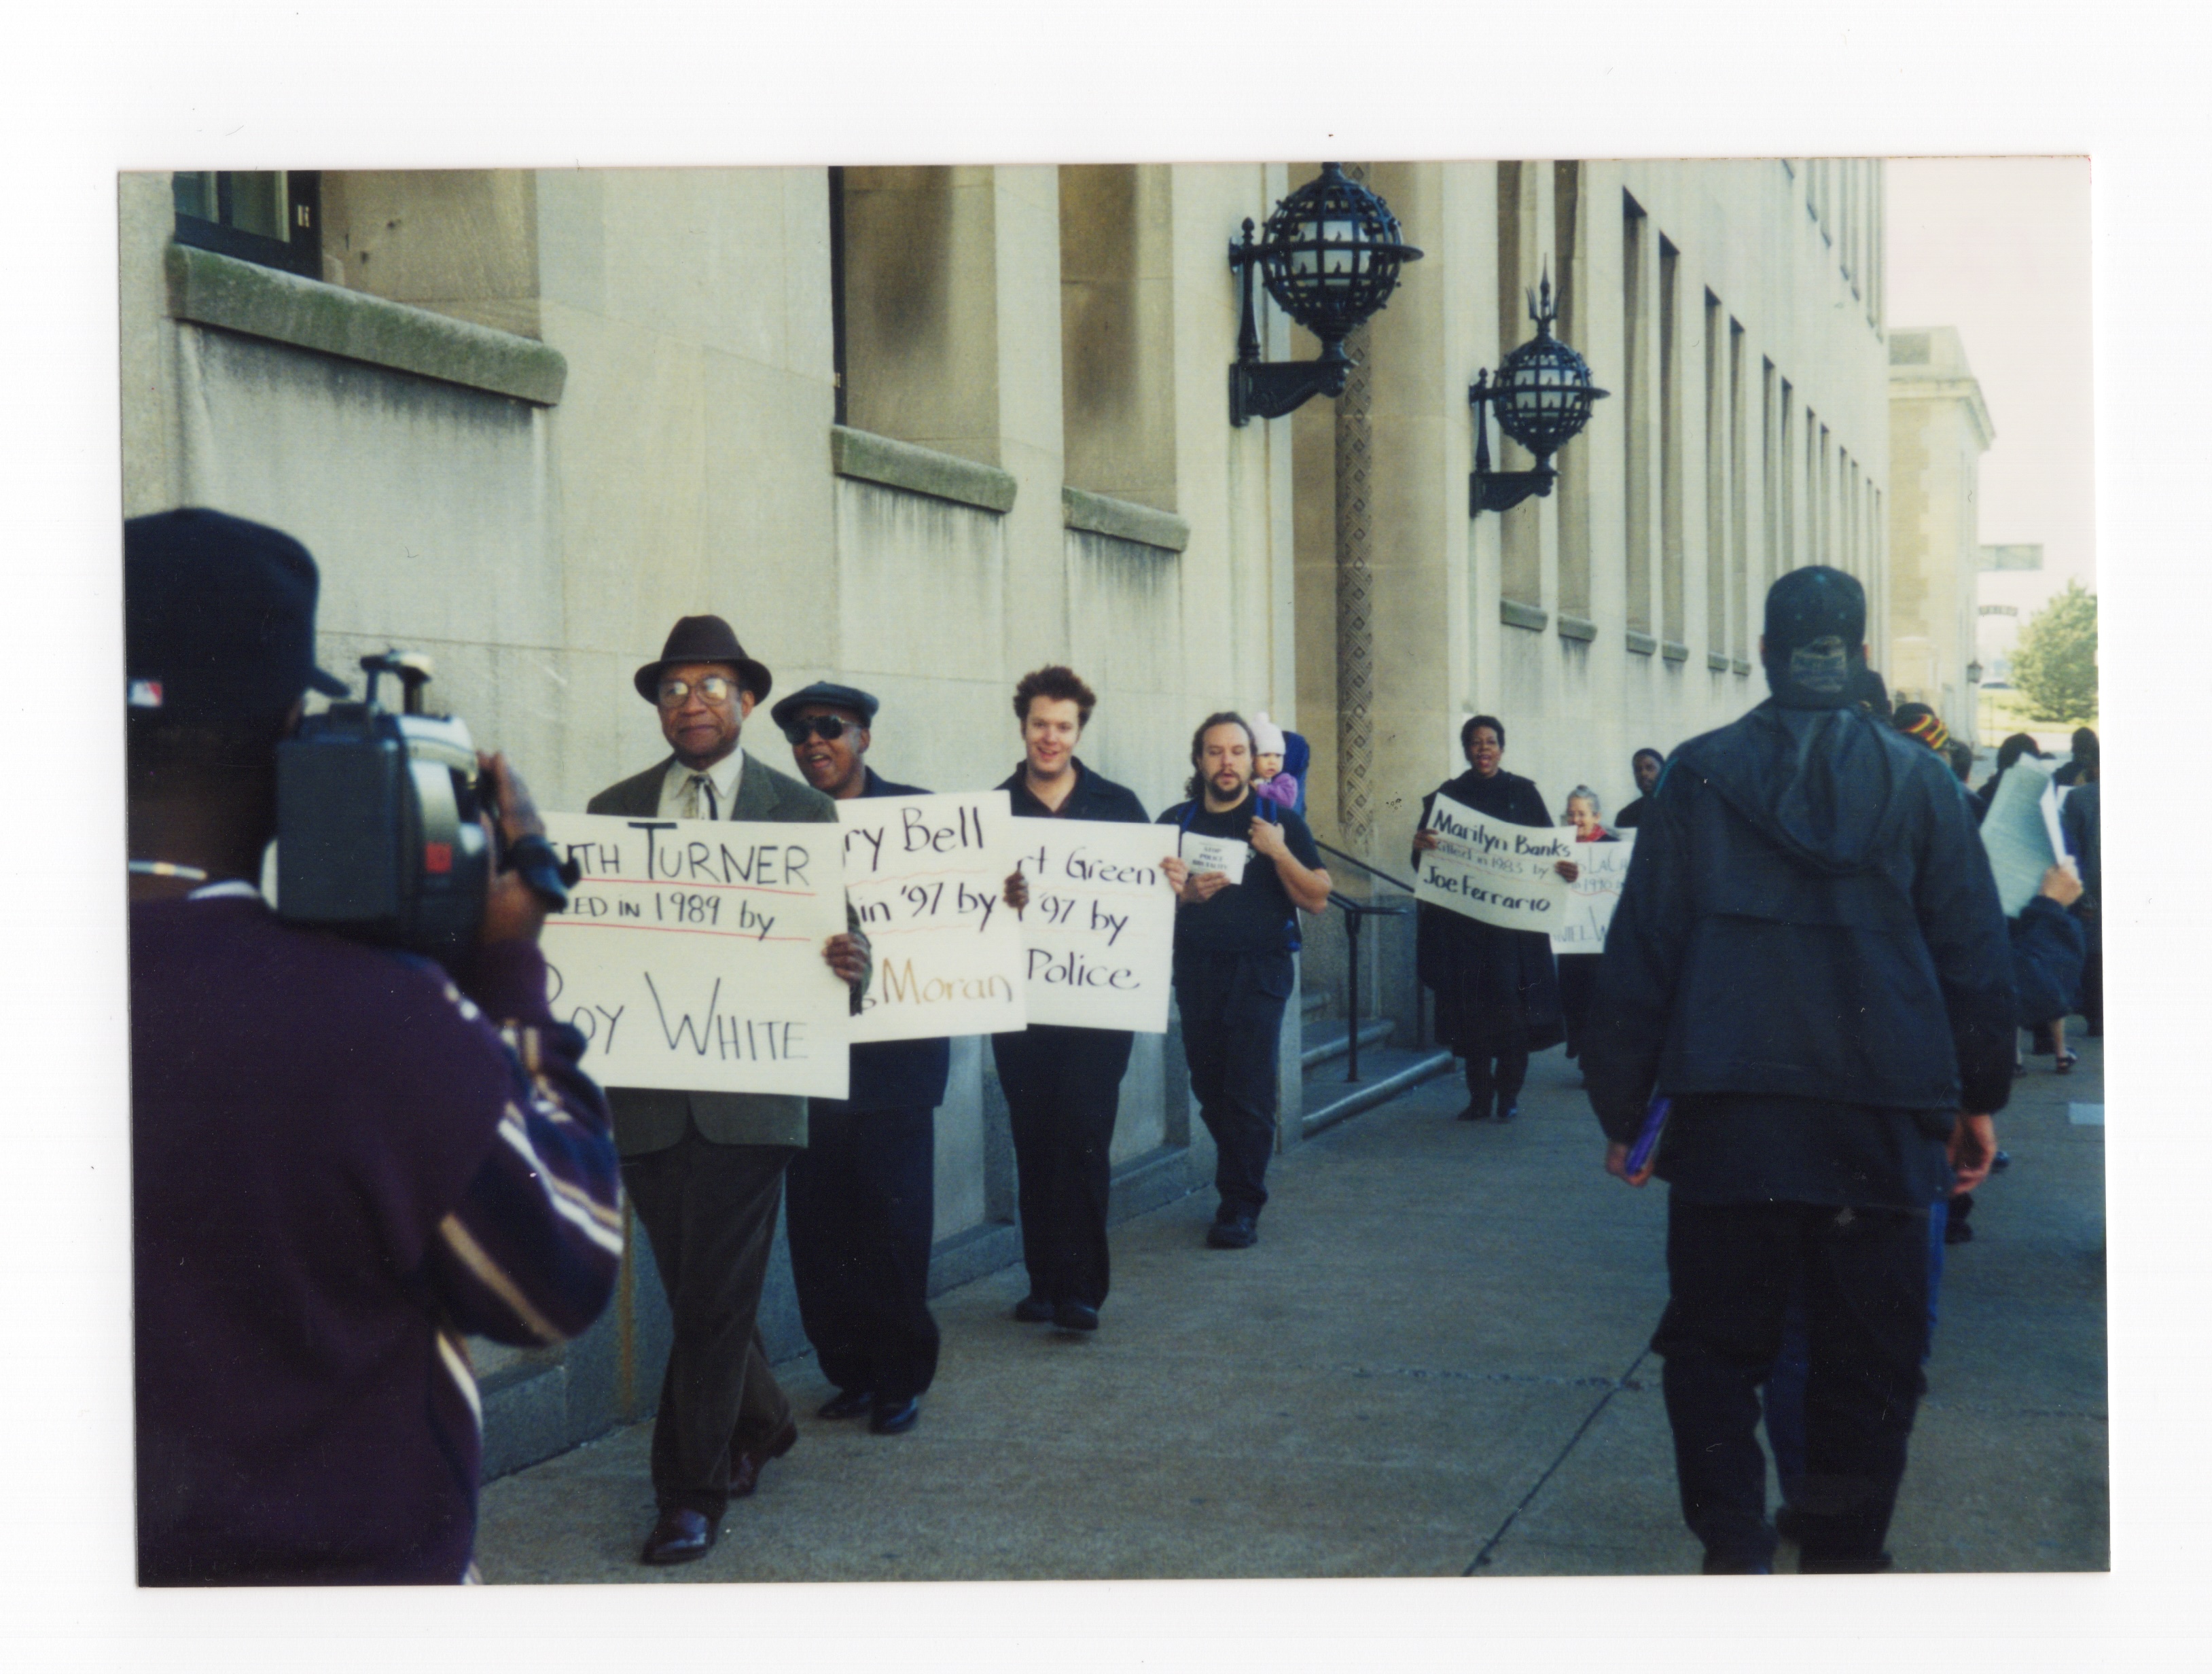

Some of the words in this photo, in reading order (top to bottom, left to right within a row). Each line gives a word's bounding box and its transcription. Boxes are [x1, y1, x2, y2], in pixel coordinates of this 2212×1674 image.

[901, 805, 984, 853] Bell
[1433, 808, 1508, 854] Marilyn
[1516, 834, 1571, 857] Banks
[627, 822, 810, 886] TURNER
[1065, 846, 1156, 886] Green
[1533, 863, 1551, 879] by
[859, 896, 891, 923] in
[900, 882, 944, 918] '97
[957, 882, 997, 933] by
[1423, 865, 1459, 893] Joe
[1462, 874, 1551, 912] Ferrario
[656, 891, 721, 925] 1989
[740, 900, 775, 942] by
[1039, 891, 1075, 924] '97
[1090, 900, 1129, 946] by
[882, 957, 1012, 1004] Moran
[1027, 948, 1141, 991] Police
[644, 971, 808, 1062] WHITE
